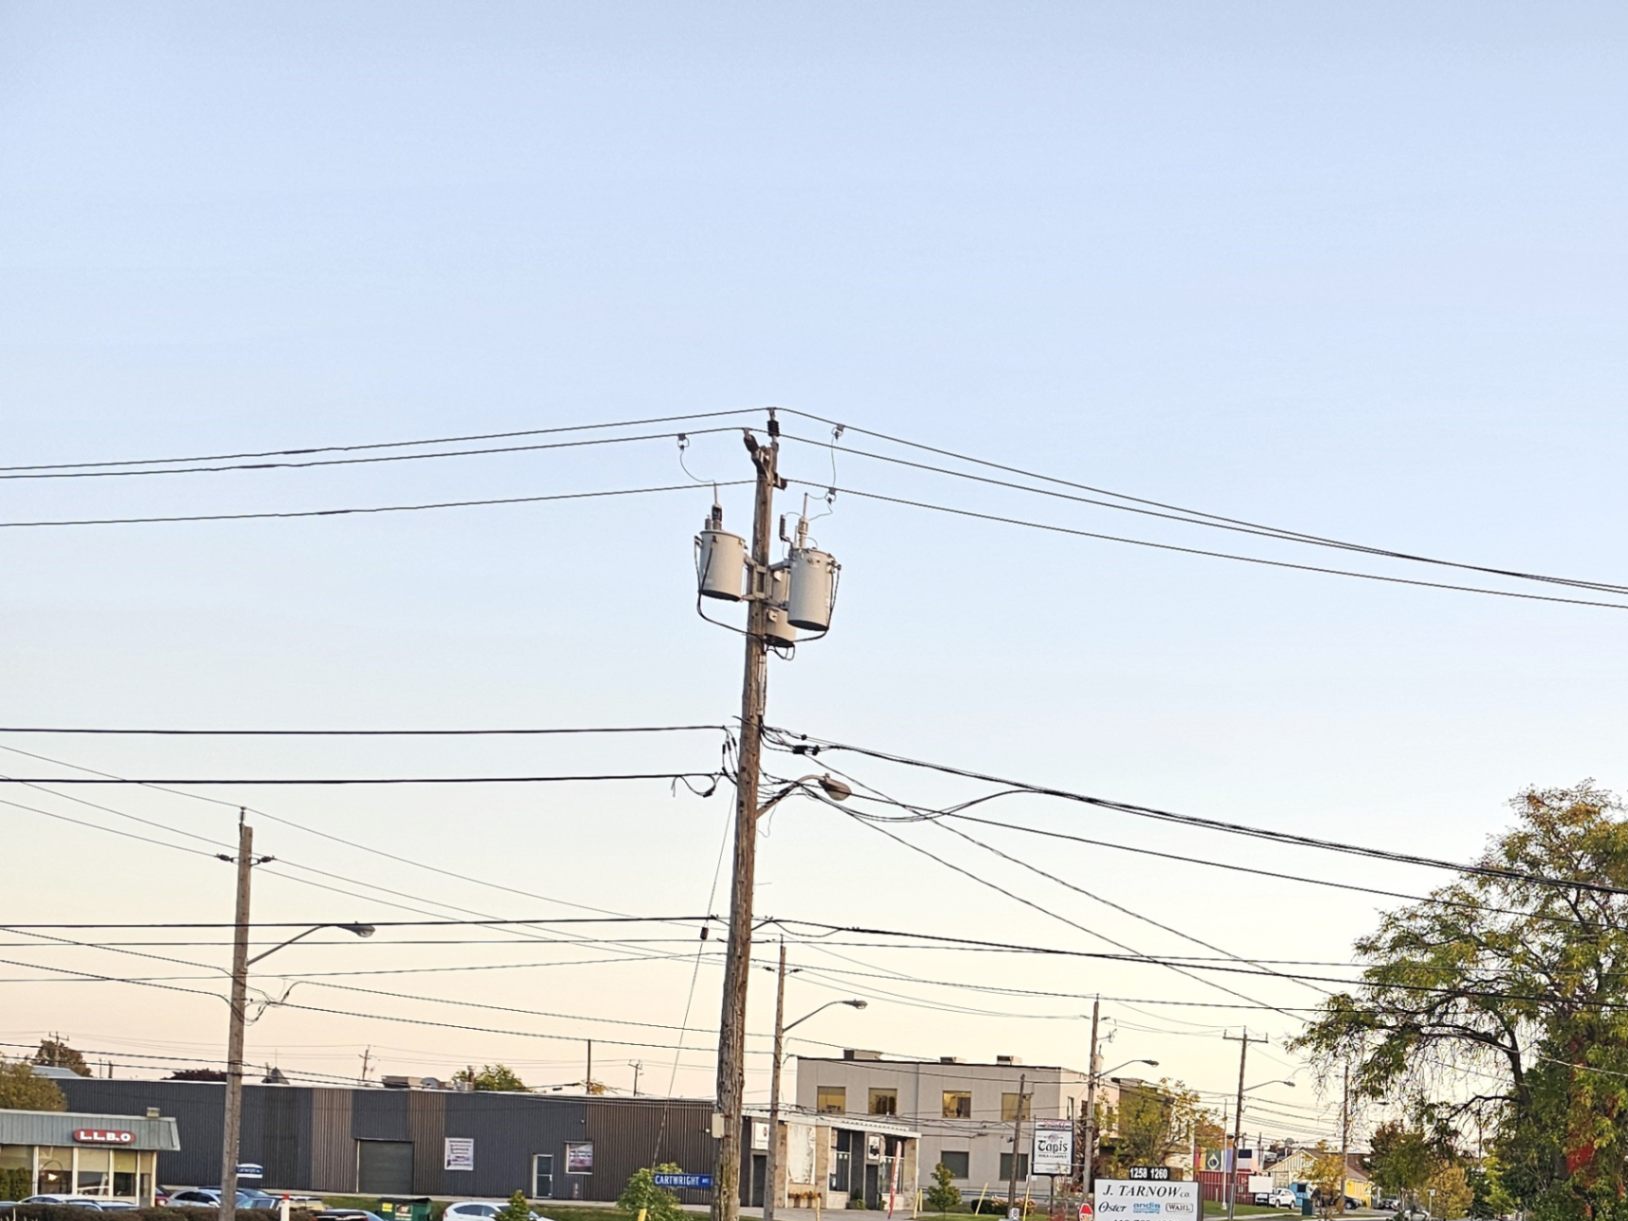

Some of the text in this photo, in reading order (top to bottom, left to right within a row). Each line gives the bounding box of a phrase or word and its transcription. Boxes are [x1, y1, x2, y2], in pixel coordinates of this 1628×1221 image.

[1150, 1168, 1168, 1179] 1260
[655, 1175, 700, 1186] CARTWRIGHT
[1102, 1184, 1113, 1196] J.
[1119, 1185, 1181, 1197] TARNOW
[1098, 1201, 1127, 1213] Oster
